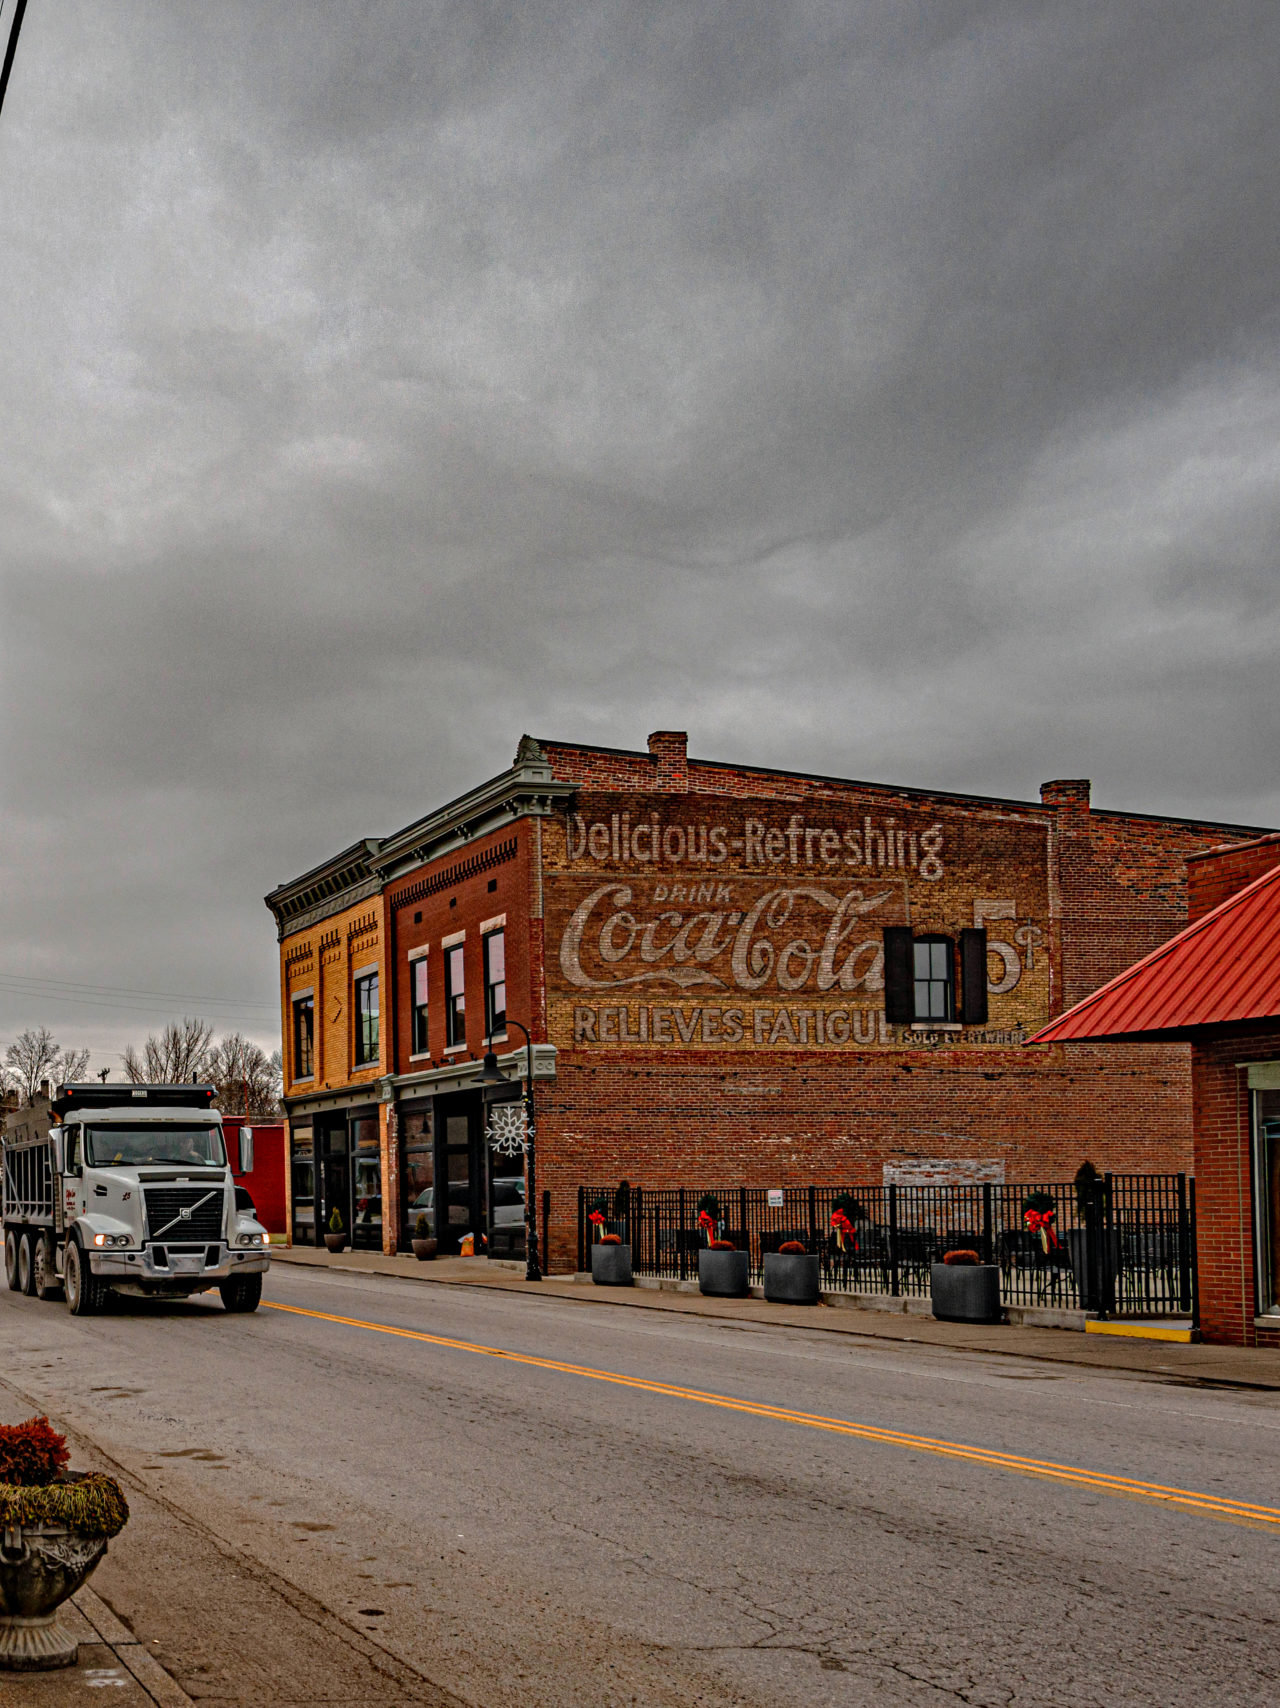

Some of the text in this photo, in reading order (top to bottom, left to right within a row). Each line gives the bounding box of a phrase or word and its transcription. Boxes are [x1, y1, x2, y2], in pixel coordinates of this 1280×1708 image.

[653, 882, 734, 902] DRINK
[573, 1007, 744, 1043] RELIEVES
[902, 1030, 939, 1044] SOLD
